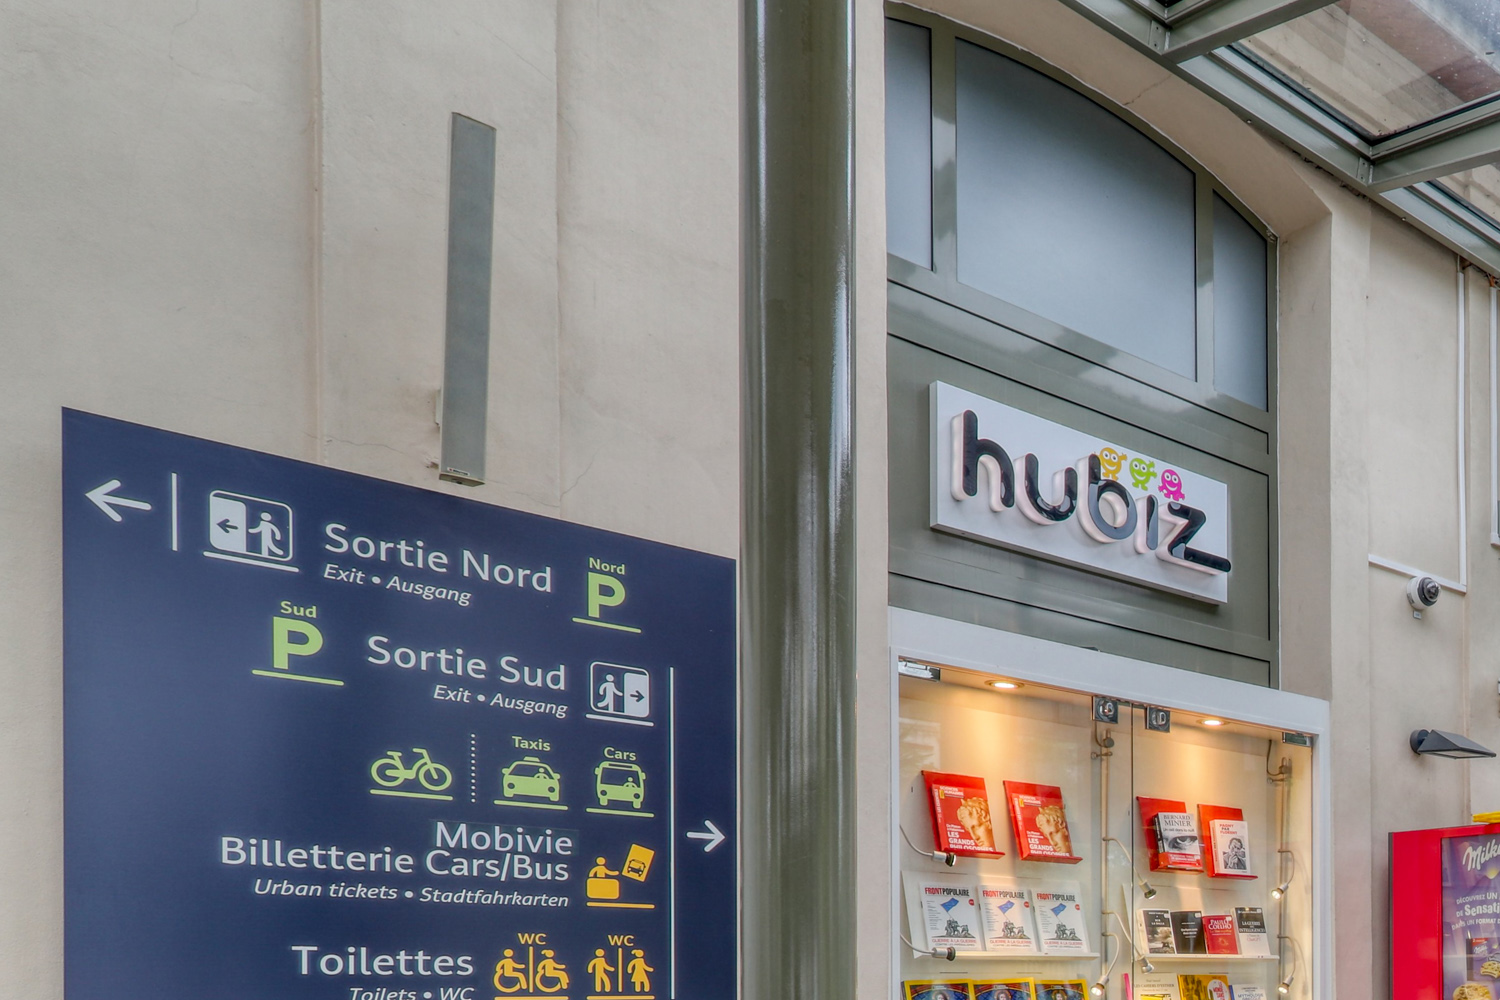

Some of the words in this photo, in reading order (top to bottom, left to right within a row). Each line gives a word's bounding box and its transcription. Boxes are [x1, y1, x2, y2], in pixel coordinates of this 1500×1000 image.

[323, 522, 449, 574] Sortie
[462, 549, 552, 595] Nord
[588, 556, 626, 577] Nord
[323, 563, 366, 587] Exit
[386, 574, 472, 607] Ausgang
[587, 572, 626, 618] P
[280, 600, 318, 620] Sud
[272, 616, 323, 670] P
[367, 635, 487, 679] Sortie
[499, 654, 567, 691] Sud
[433, 683, 472, 705] Exit
[490, 692, 568, 719] Ausgang
[512, 735, 550, 751] Taxis
[603, 746, 637, 762] Cars
[434, 820, 574, 856] Mobivie
[220, 835, 413, 875] Billetterie
[426, 848, 570, 882] Cars/Bus
[253, 878, 325, 899] Urban
[331, 879, 398, 900] tickets
[419, 886, 569, 909] Stadtfahrkarten
[1486, 892, 1498, 900] UN
[517, 932, 547, 946] WC
[607, 934, 635, 947] WC
[292, 945, 475, 978] Toilettes
